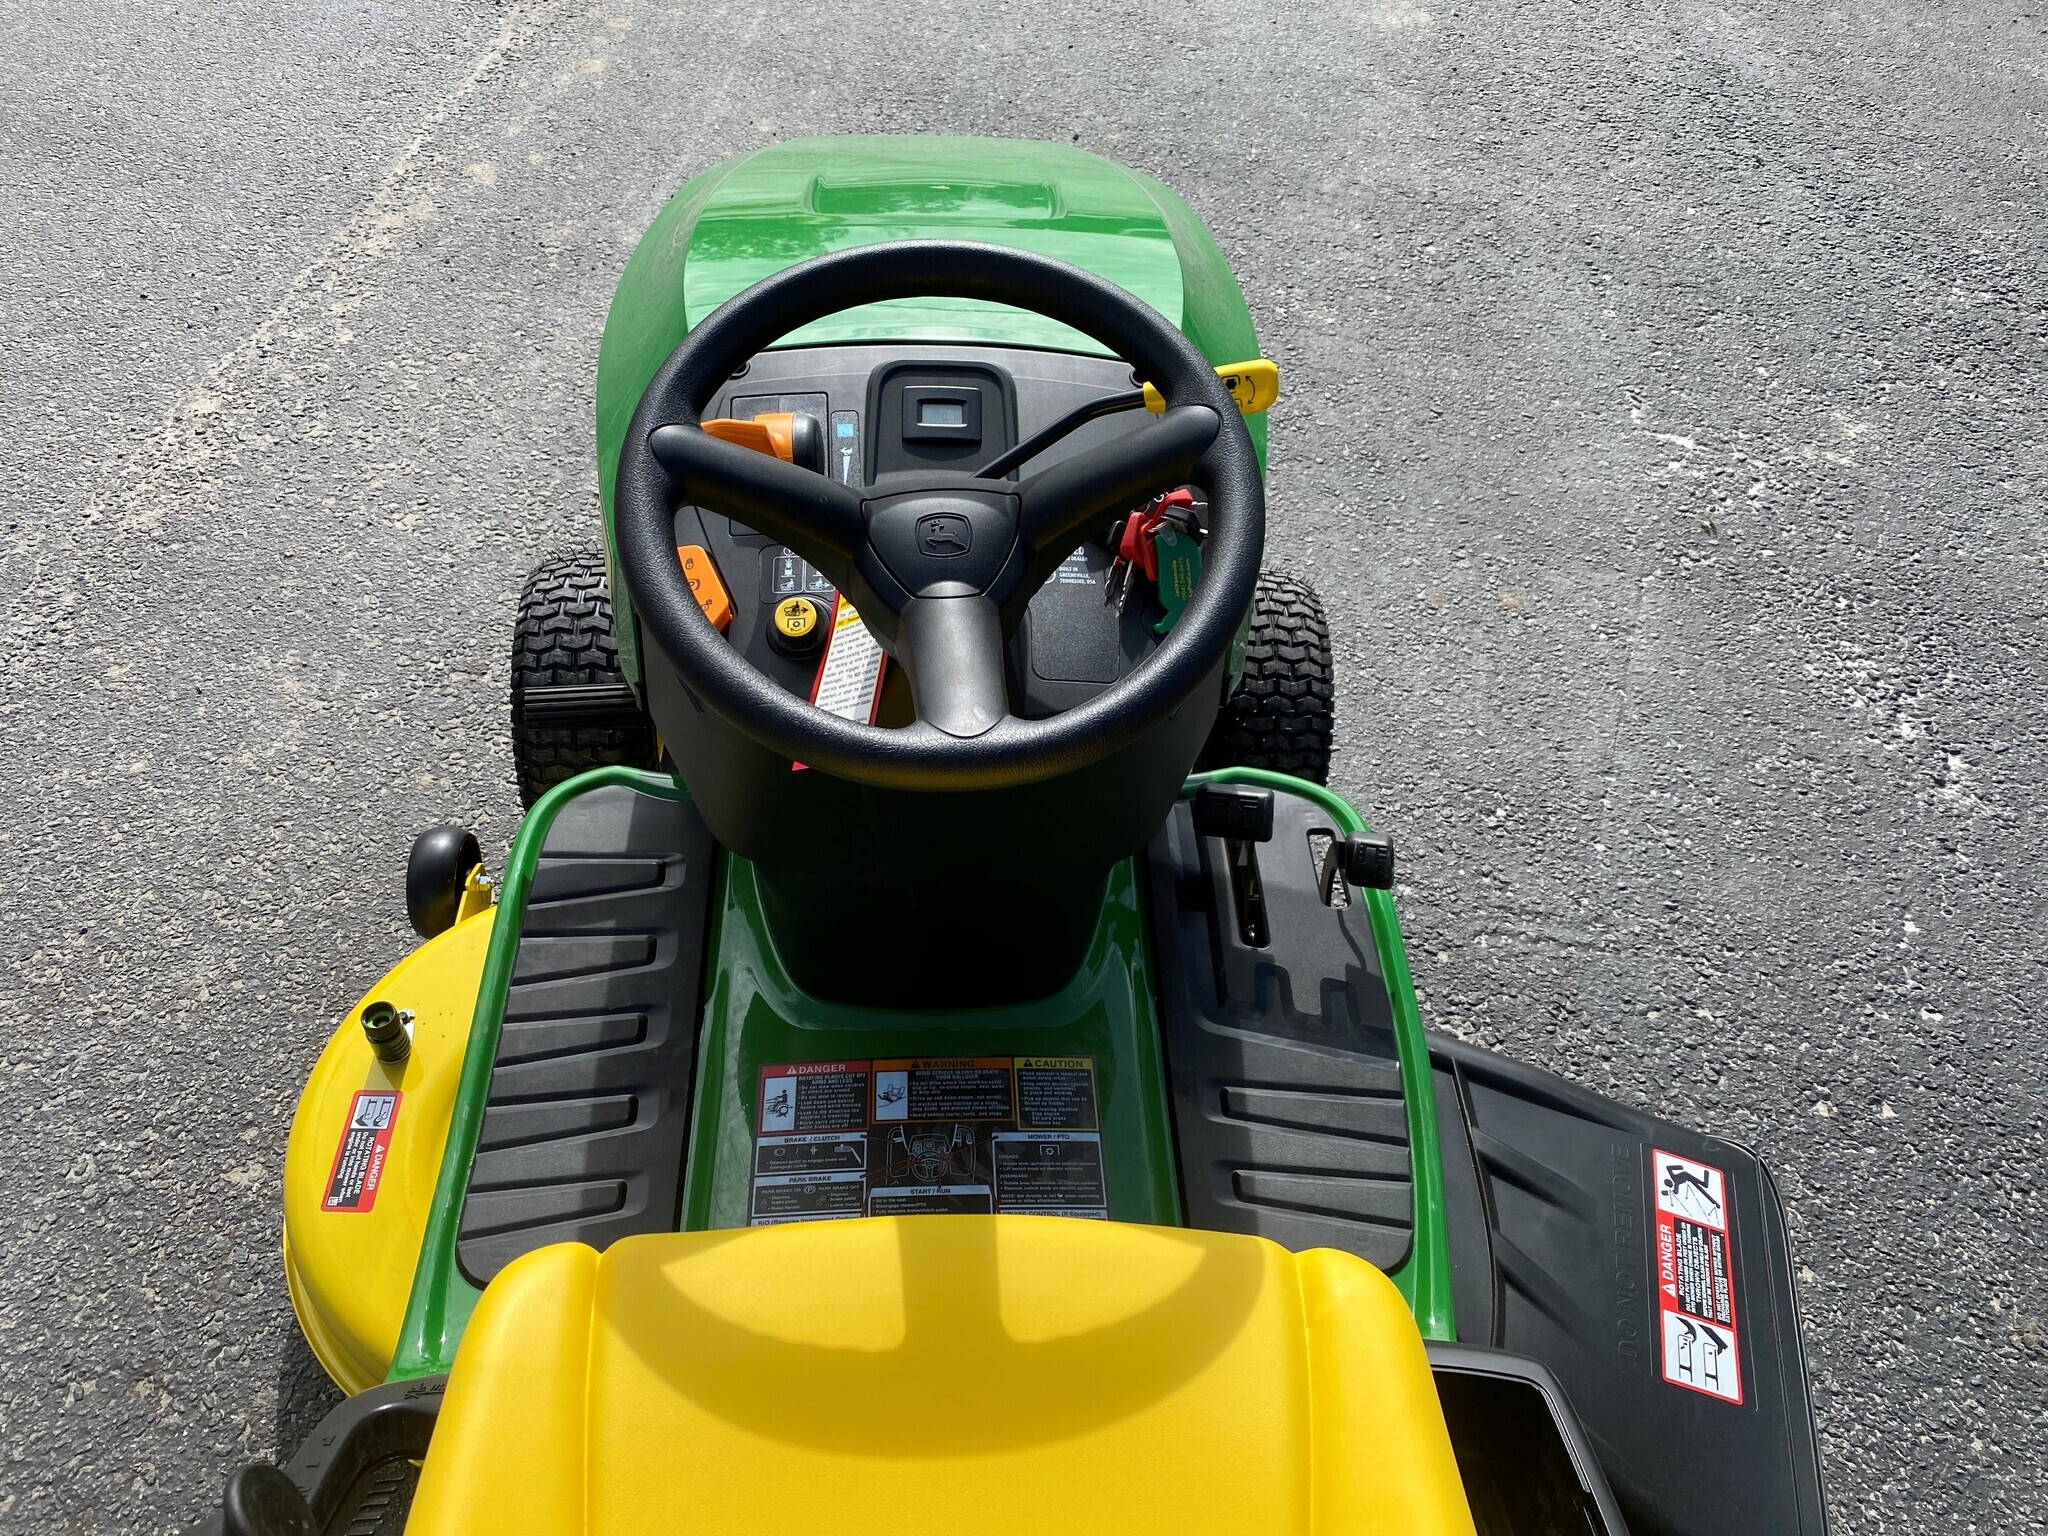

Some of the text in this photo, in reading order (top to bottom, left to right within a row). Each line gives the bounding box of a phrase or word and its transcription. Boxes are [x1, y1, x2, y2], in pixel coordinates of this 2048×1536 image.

[1172, 560, 1180, 597] Jacksonville
[799, 1064, 846, 1074] DANGER
[922, 1060, 975, 1068] WARNING
[1034, 1060, 1083, 1068] CAUTION
[353, 1137, 374, 1194] ROTATING BLADE
[367, 1154, 383, 1190] DANGER
[1611, 1143, 1638, 1357] DO NOT REMOVE
[1660, 1224, 1674, 1280] DANGER
